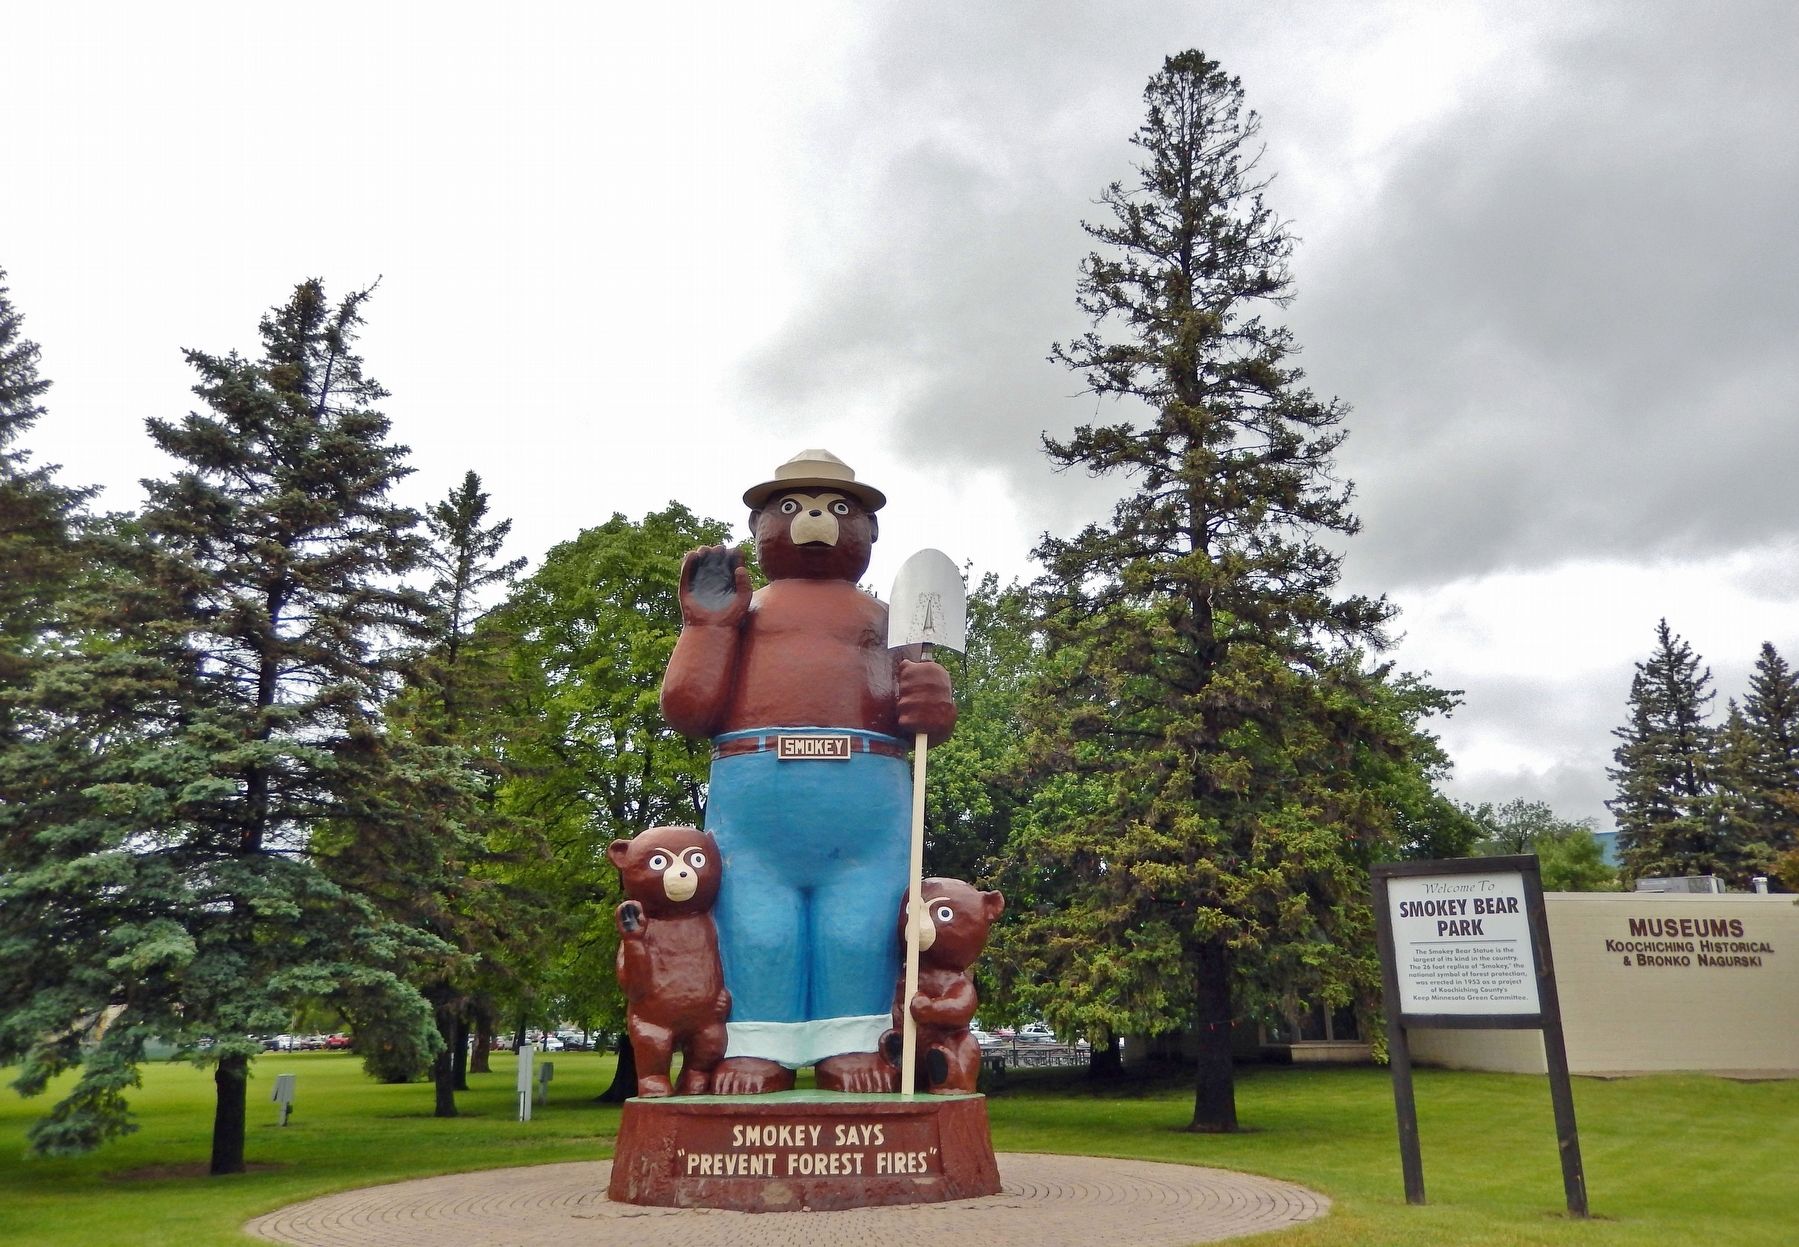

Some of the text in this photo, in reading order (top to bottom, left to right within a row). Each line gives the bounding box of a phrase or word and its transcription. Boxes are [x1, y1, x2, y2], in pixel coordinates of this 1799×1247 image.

[785, 740, 843, 754] SMOKEY
[1422, 880, 1494, 894] Welcome To
[1400, 897, 1519, 917] SMOKEY BEAR
[1438, 919, 1484, 936] PARK
[1629, 918, 1744, 937] MUSEUMS
[1623, 956, 1631, 966] &
[733, 1124, 885, 1147] SMOKEY SAYS
[678, 1147, 938, 1175] "PREVENT FOREST FIRES"
